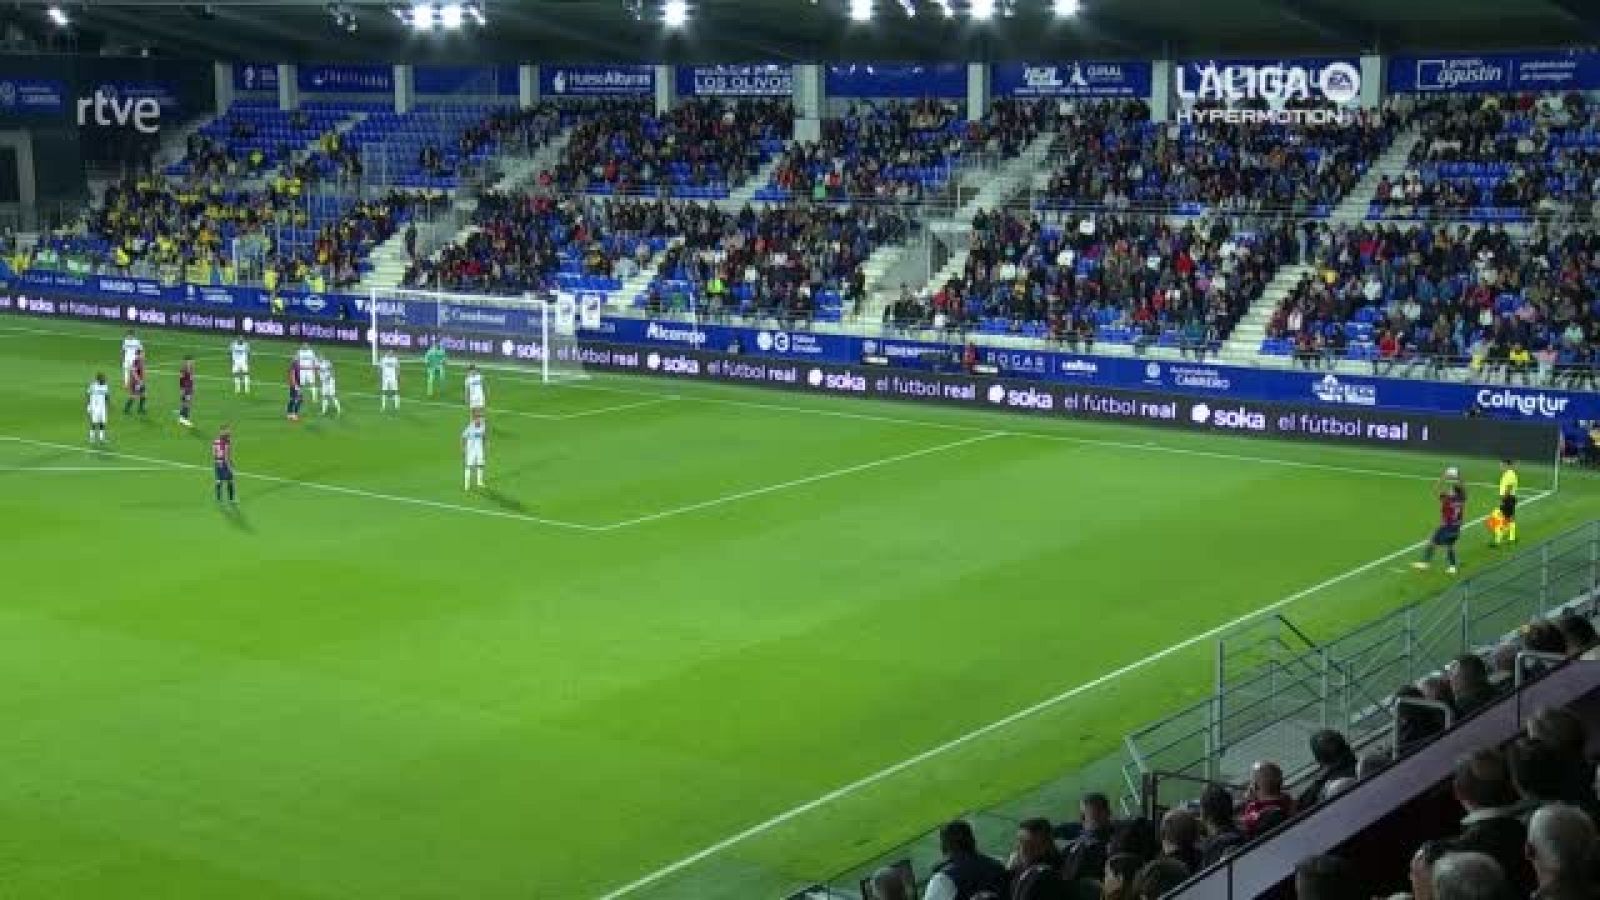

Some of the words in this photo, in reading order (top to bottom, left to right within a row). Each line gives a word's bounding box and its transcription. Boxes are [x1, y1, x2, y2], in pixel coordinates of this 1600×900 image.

[379, 328, 411, 346] soka
[469, 340, 493, 353] real
[517, 342, 547, 359] soka
[612, 352, 639, 366] real
[663, 355, 699, 373] soka
[707, 360, 721, 374] el
[769, 367, 797, 382] real
[825, 370, 866, 391] soka
[875, 376, 889, 391] el
[944, 382, 976, 399] real
[1008, 387, 1053, 408] soka
[1064, 392, 1079, 408] el
[1140, 402, 1177, 419] real
[1477, 389, 1570, 417] Colnatur
[1214, 405, 1265, 429] soka
[1279, 412, 1296, 431] el
[1366, 422, 1409, 441] real
